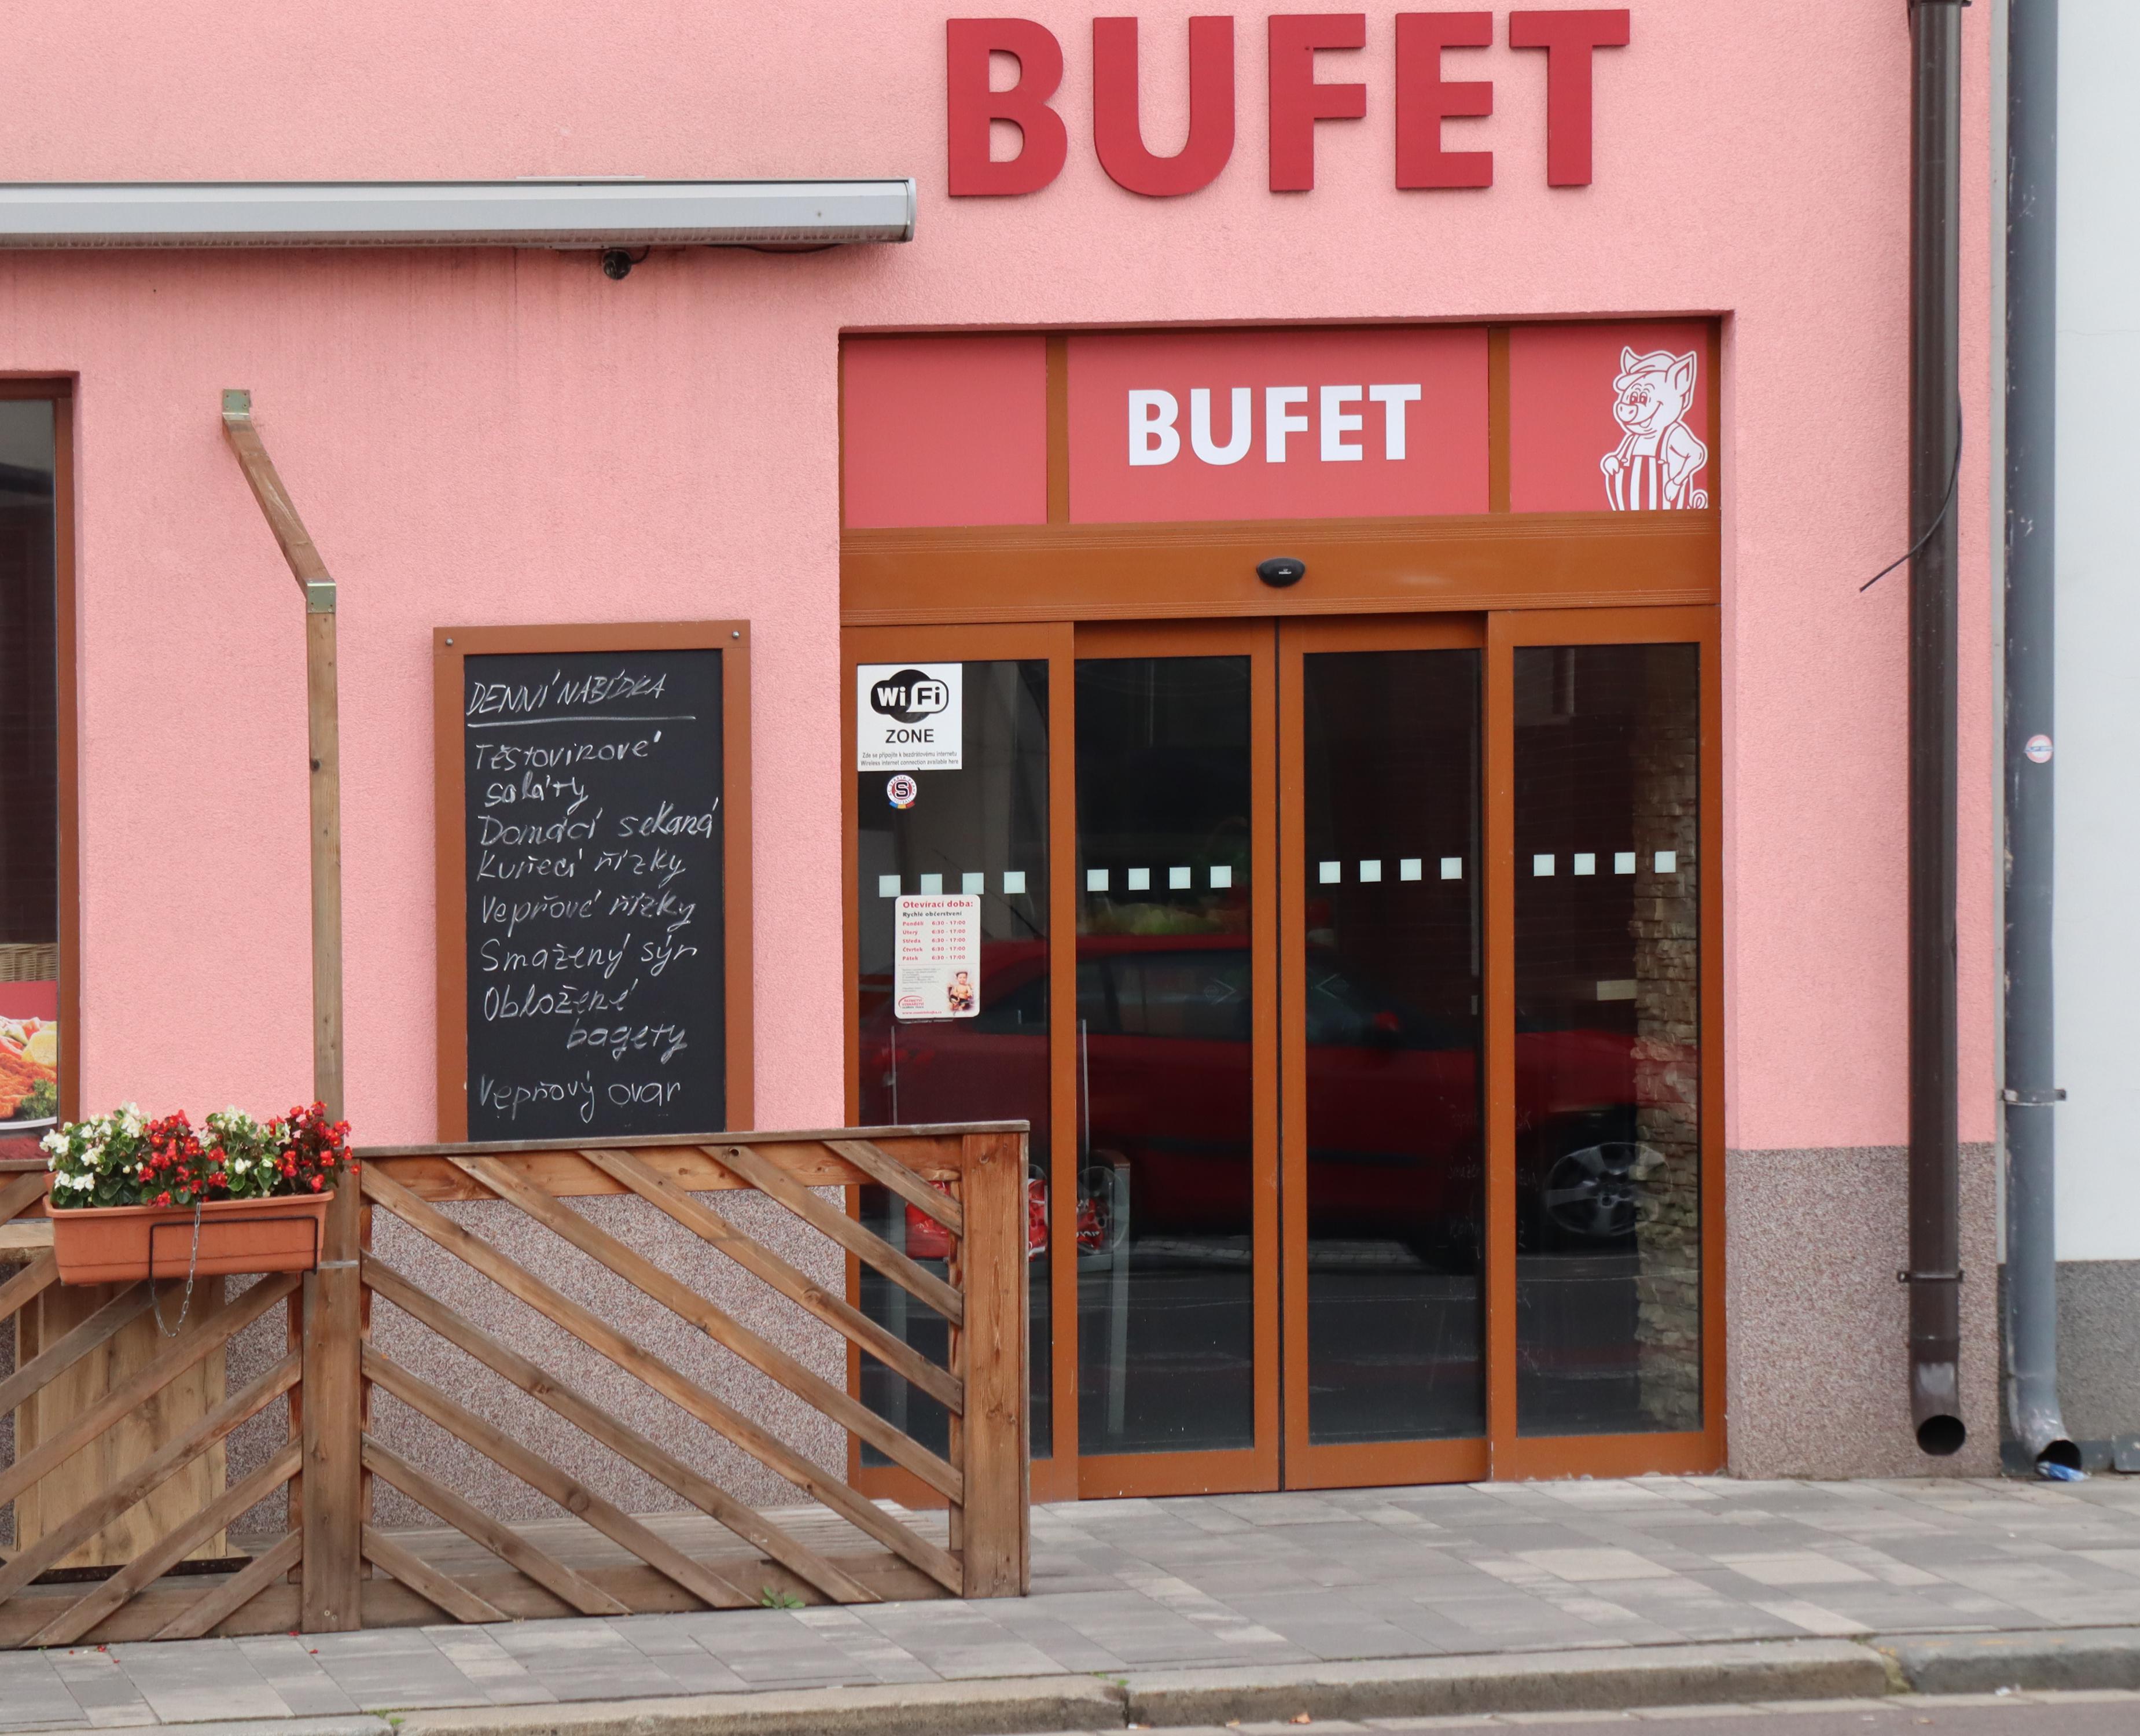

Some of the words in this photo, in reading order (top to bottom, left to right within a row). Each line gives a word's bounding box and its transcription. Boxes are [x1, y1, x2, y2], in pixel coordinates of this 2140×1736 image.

[947, 9, 1630, 197] BUFET
[1128, 384, 1421, 466] BUFET
[885, 729, 935, 744] ZONE
[896, 782, 909, 797] S
[903, 900, 944, 909] Otevírací
[947, 900, 973, 908] doba:
[566, 1018, 687, 1064] bagety
